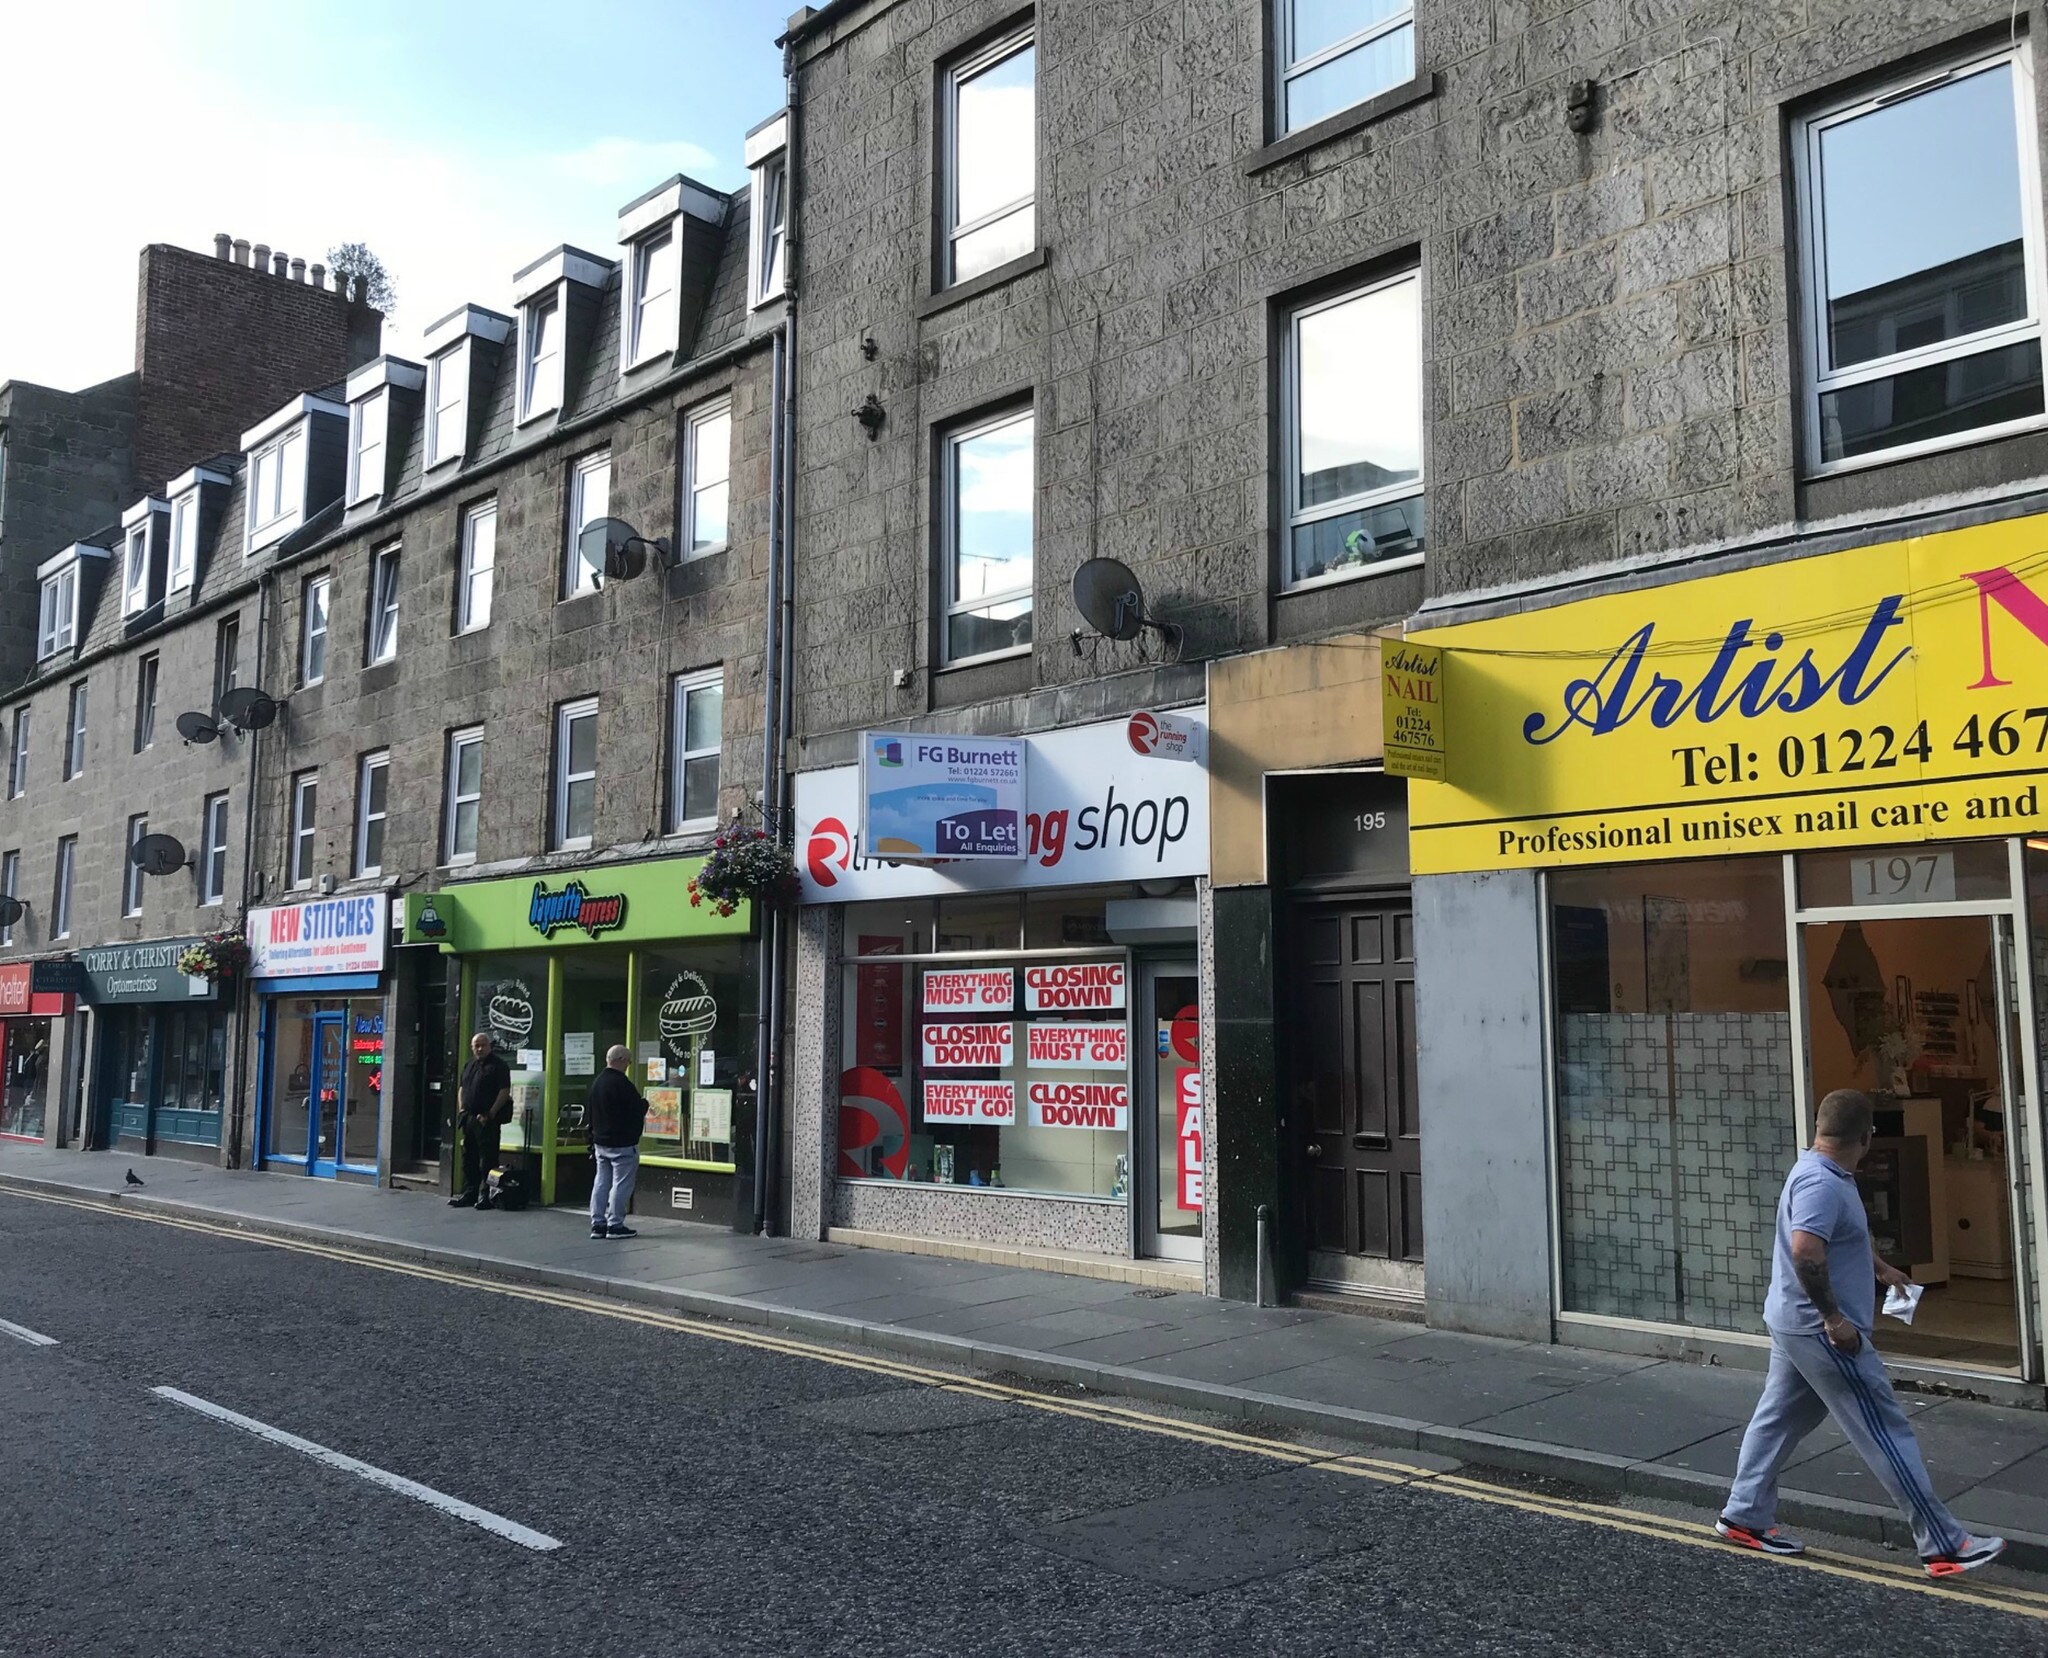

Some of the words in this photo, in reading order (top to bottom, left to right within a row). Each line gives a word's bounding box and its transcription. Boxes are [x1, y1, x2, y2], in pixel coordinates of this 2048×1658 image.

[1385, 649, 1439, 677] Artist
[1522, 594, 1912, 745] Artist
[1387, 675, 1439, 704] NAIL
[1406, 707, 1421, 718] Tel:
[1161, 720, 1172, 731] the
[1396, 716, 1431, 731] 01224
[1160, 731, 1187, 744] running
[1166, 741, 1183, 754] shop
[1393, 730, 1435, 747] 467576
[918, 746, 943, 764] FG
[948, 747, 1018, 766] Burnett
[1672, 742, 1760, 788] Tel:
[1778, 719, 1933, 778] 01224
[948, 767, 962, 776] Tel:
[964, 767, 988, 777] 01224
[990, 768, 1019, 777] 572661
[948, 776, 1017, 785] www.fgburnett.co.uk
[1074, 786, 1191, 863] shop
[1353, 812, 1386, 831] 195
[1498, 817, 1672, 856] Professional
[1682, 811, 1784, 842] unisex
[1795, 801, 1859, 833] nail
[1871, 800, 1949, 828] care
[1965, 785, 2040, 820] and
[941, 820, 970, 841] To
[980, 820, 1016, 842] Let
[960, 843, 973, 851] All
[976, 843, 1017, 853] Enquiries
[1864, 854, 1939, 896] 197
[531, 886, 581, 931] baguette
[578, 899, 619, 932] express
[270, 906, 300, 944] NEW
[303, 896, 375, 942] STITCHES
[86, 949, 120, 973] CORRY
[121, 954, 130, 970] &
[107, 974, 157, 999] Optometrists
[926, 973, 1012, 989] EVERYTHING
[1027, 965, 1123, 989] CLOSING
[926, 987, 976, 1005] MUST
[981, 987, 1012, 1004] GO!
[1038, 986, 1112, 1008] DOWN
[355, 1015, 373, 1034] New
[924, 1025, 1011, 1045] CLOSING
[1029, 1028, 1126, 1043] EVERYTHING
[935, 1045, 1001, 1064] DOWN
[1029, 1042, 1090, 1060] MUST
[1091, 1043, 1126, 1062] GO!
[926, 1085, 1013, 1099] EVERYTHING
[1030, 1084, 1128, 1107] CLOSING
[926, 1099, 976, 1116] MUST
[981, 1099, 1013, 1117] GO!
[1042, 1105, 1115, 1127] DOWN
